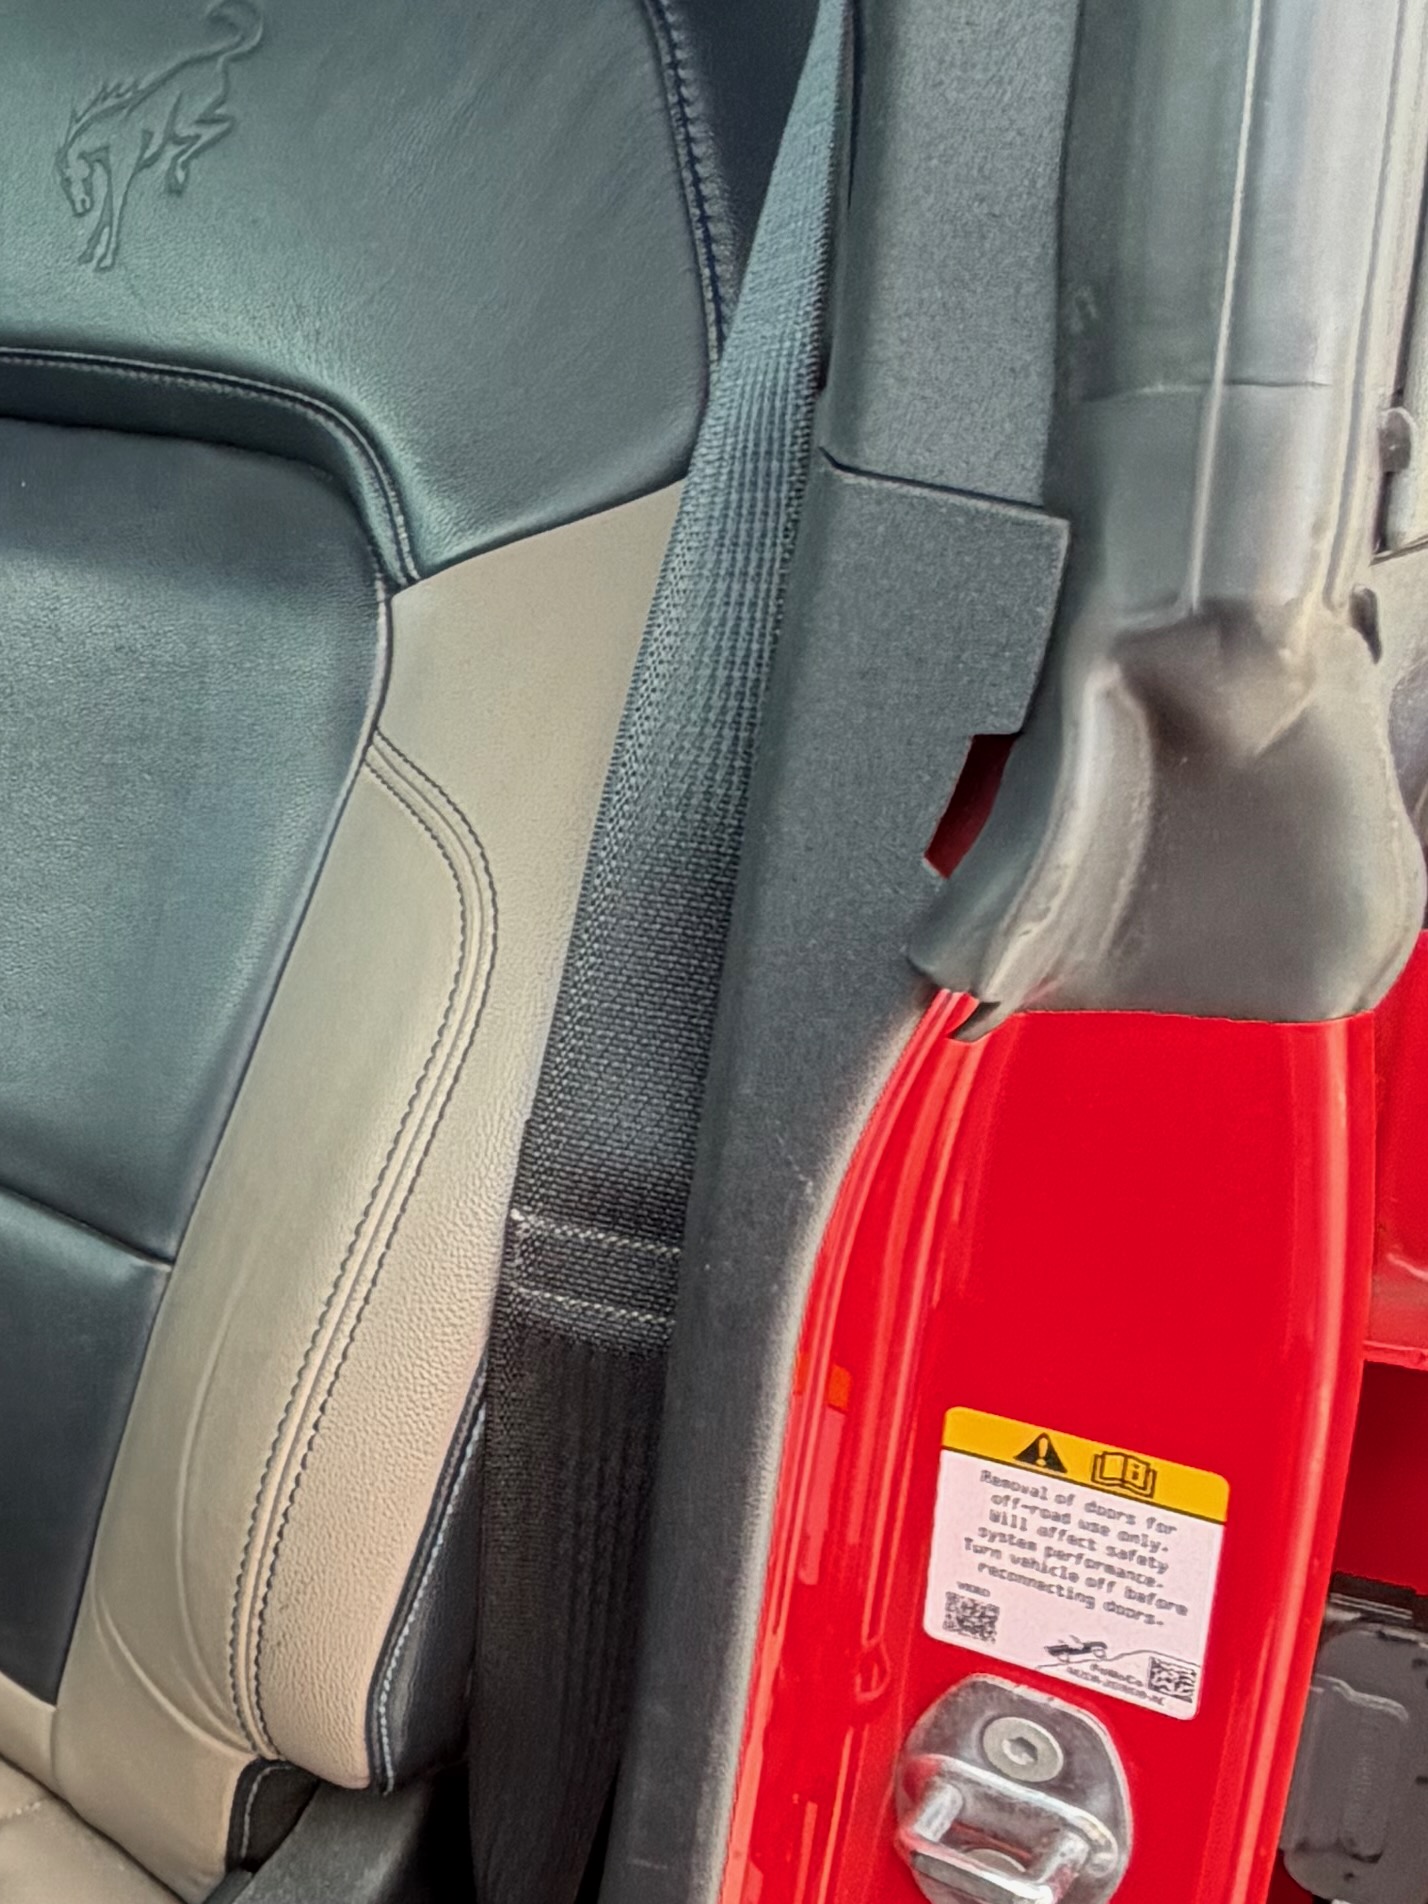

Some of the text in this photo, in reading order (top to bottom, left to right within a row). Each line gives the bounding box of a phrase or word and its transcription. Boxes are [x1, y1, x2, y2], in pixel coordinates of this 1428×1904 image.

[979, 1469, 1177, 1534] Removal of doors for
[989, 1509, 1027, 1531] Will
[1105, 1545, 1168, 1574] safety
[1009, 1554, 1079, 1582] vehicle
[1084, 1576, 1116, 1593] off
